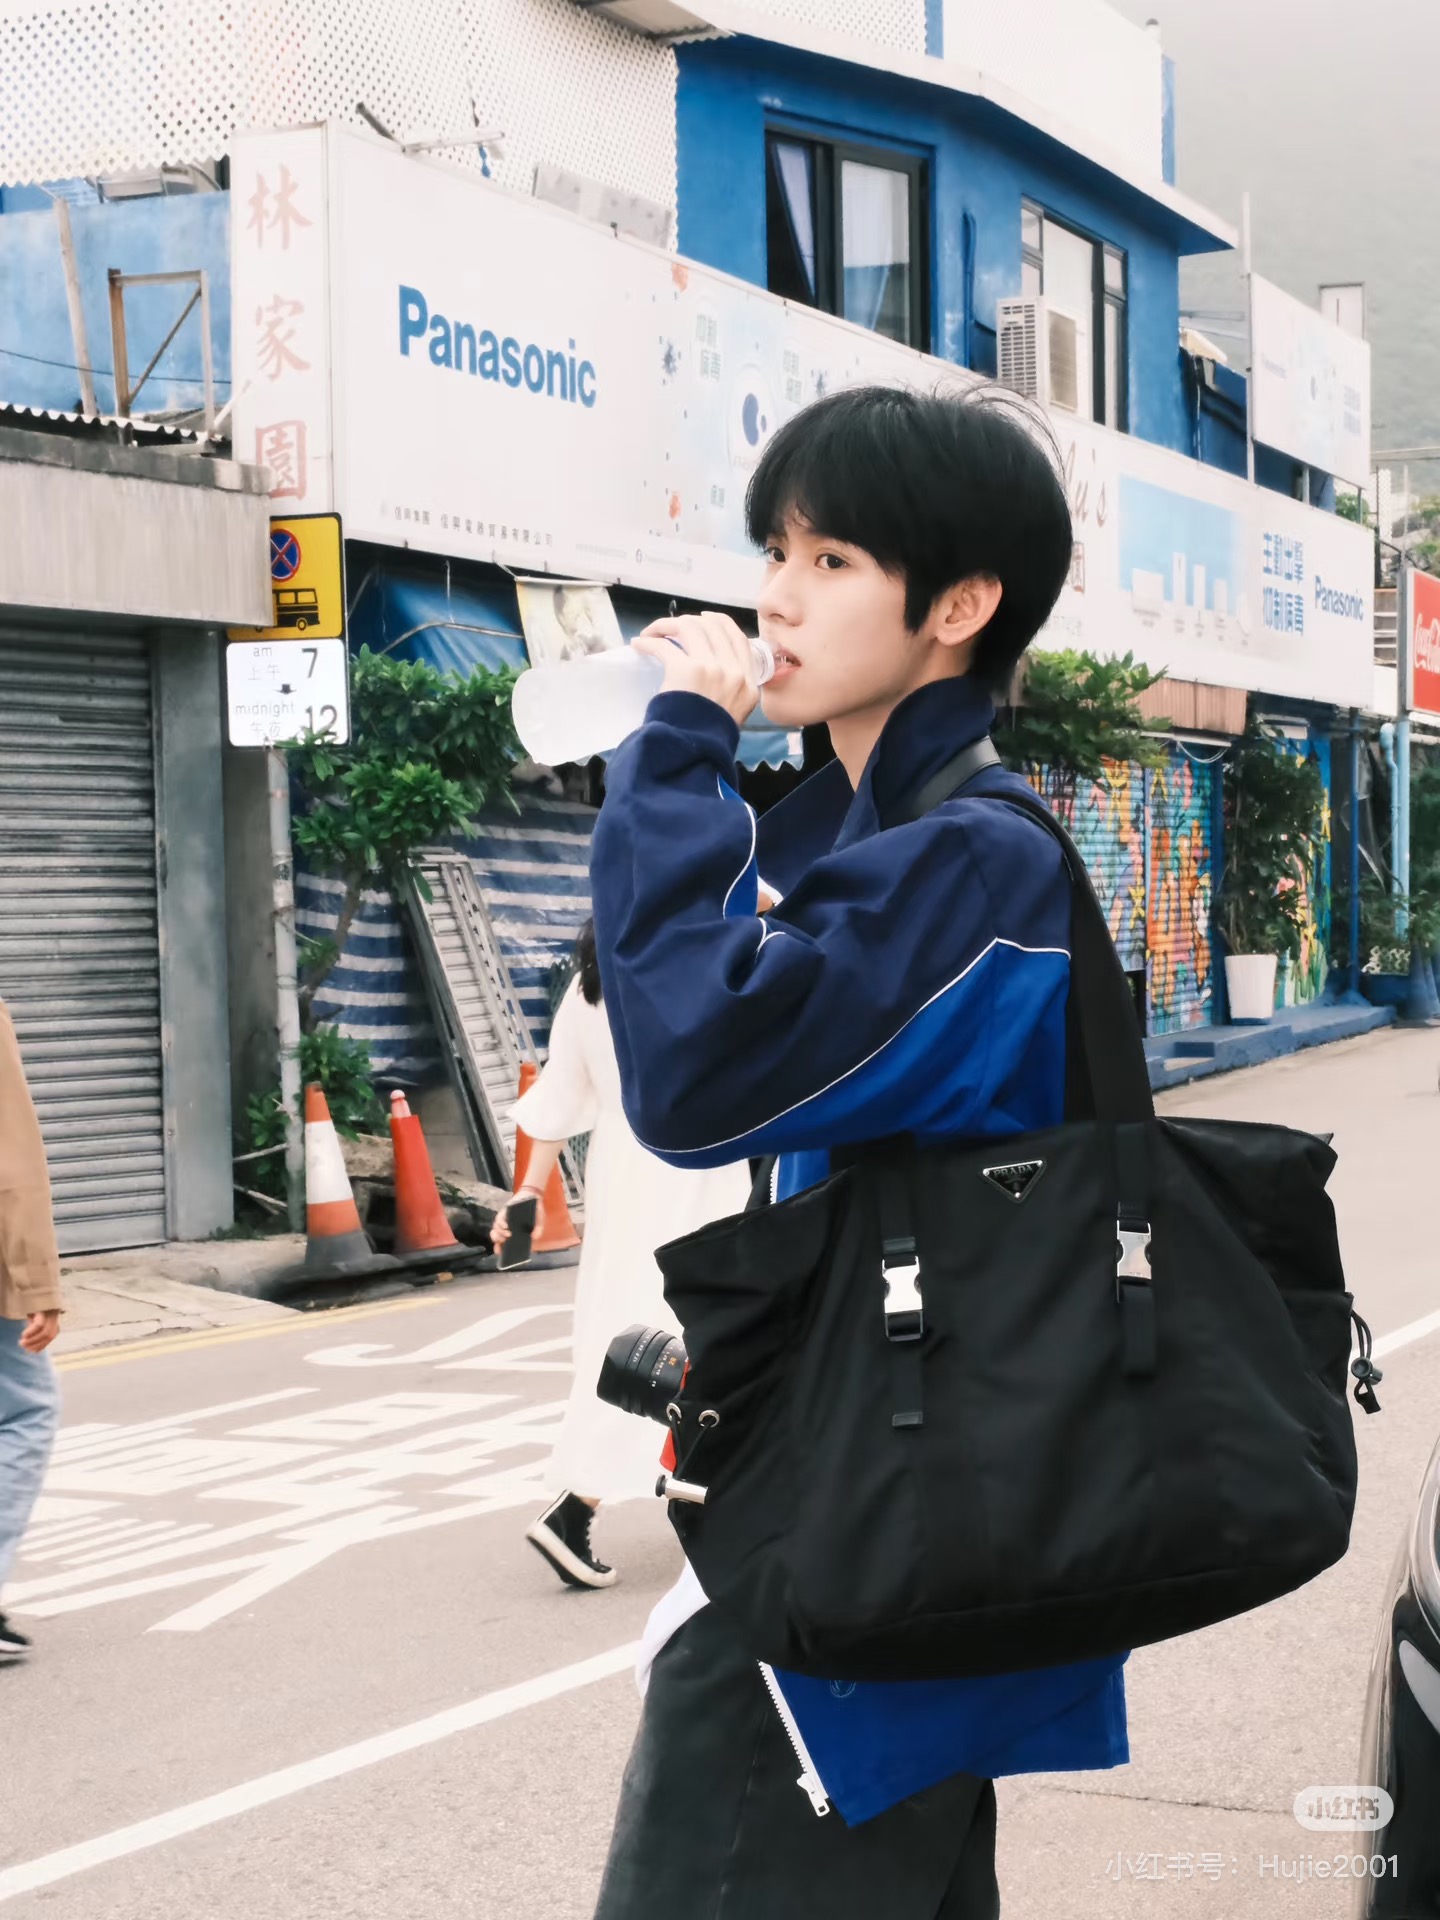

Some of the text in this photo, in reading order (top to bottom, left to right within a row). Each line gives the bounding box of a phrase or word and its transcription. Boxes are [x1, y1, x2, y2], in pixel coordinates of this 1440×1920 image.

[247, 163, 313, 500] 林家園
[399, 284, 596, 408] Panasonic
[1314, 575, 1364, 621] Panasonic
[248, 664, 281, 681] 上午
[253, 647, 318, 679] am 7
[235, 700, 337, 736] midnight 12
[994, 1164, 1034, 1176] PRADA
